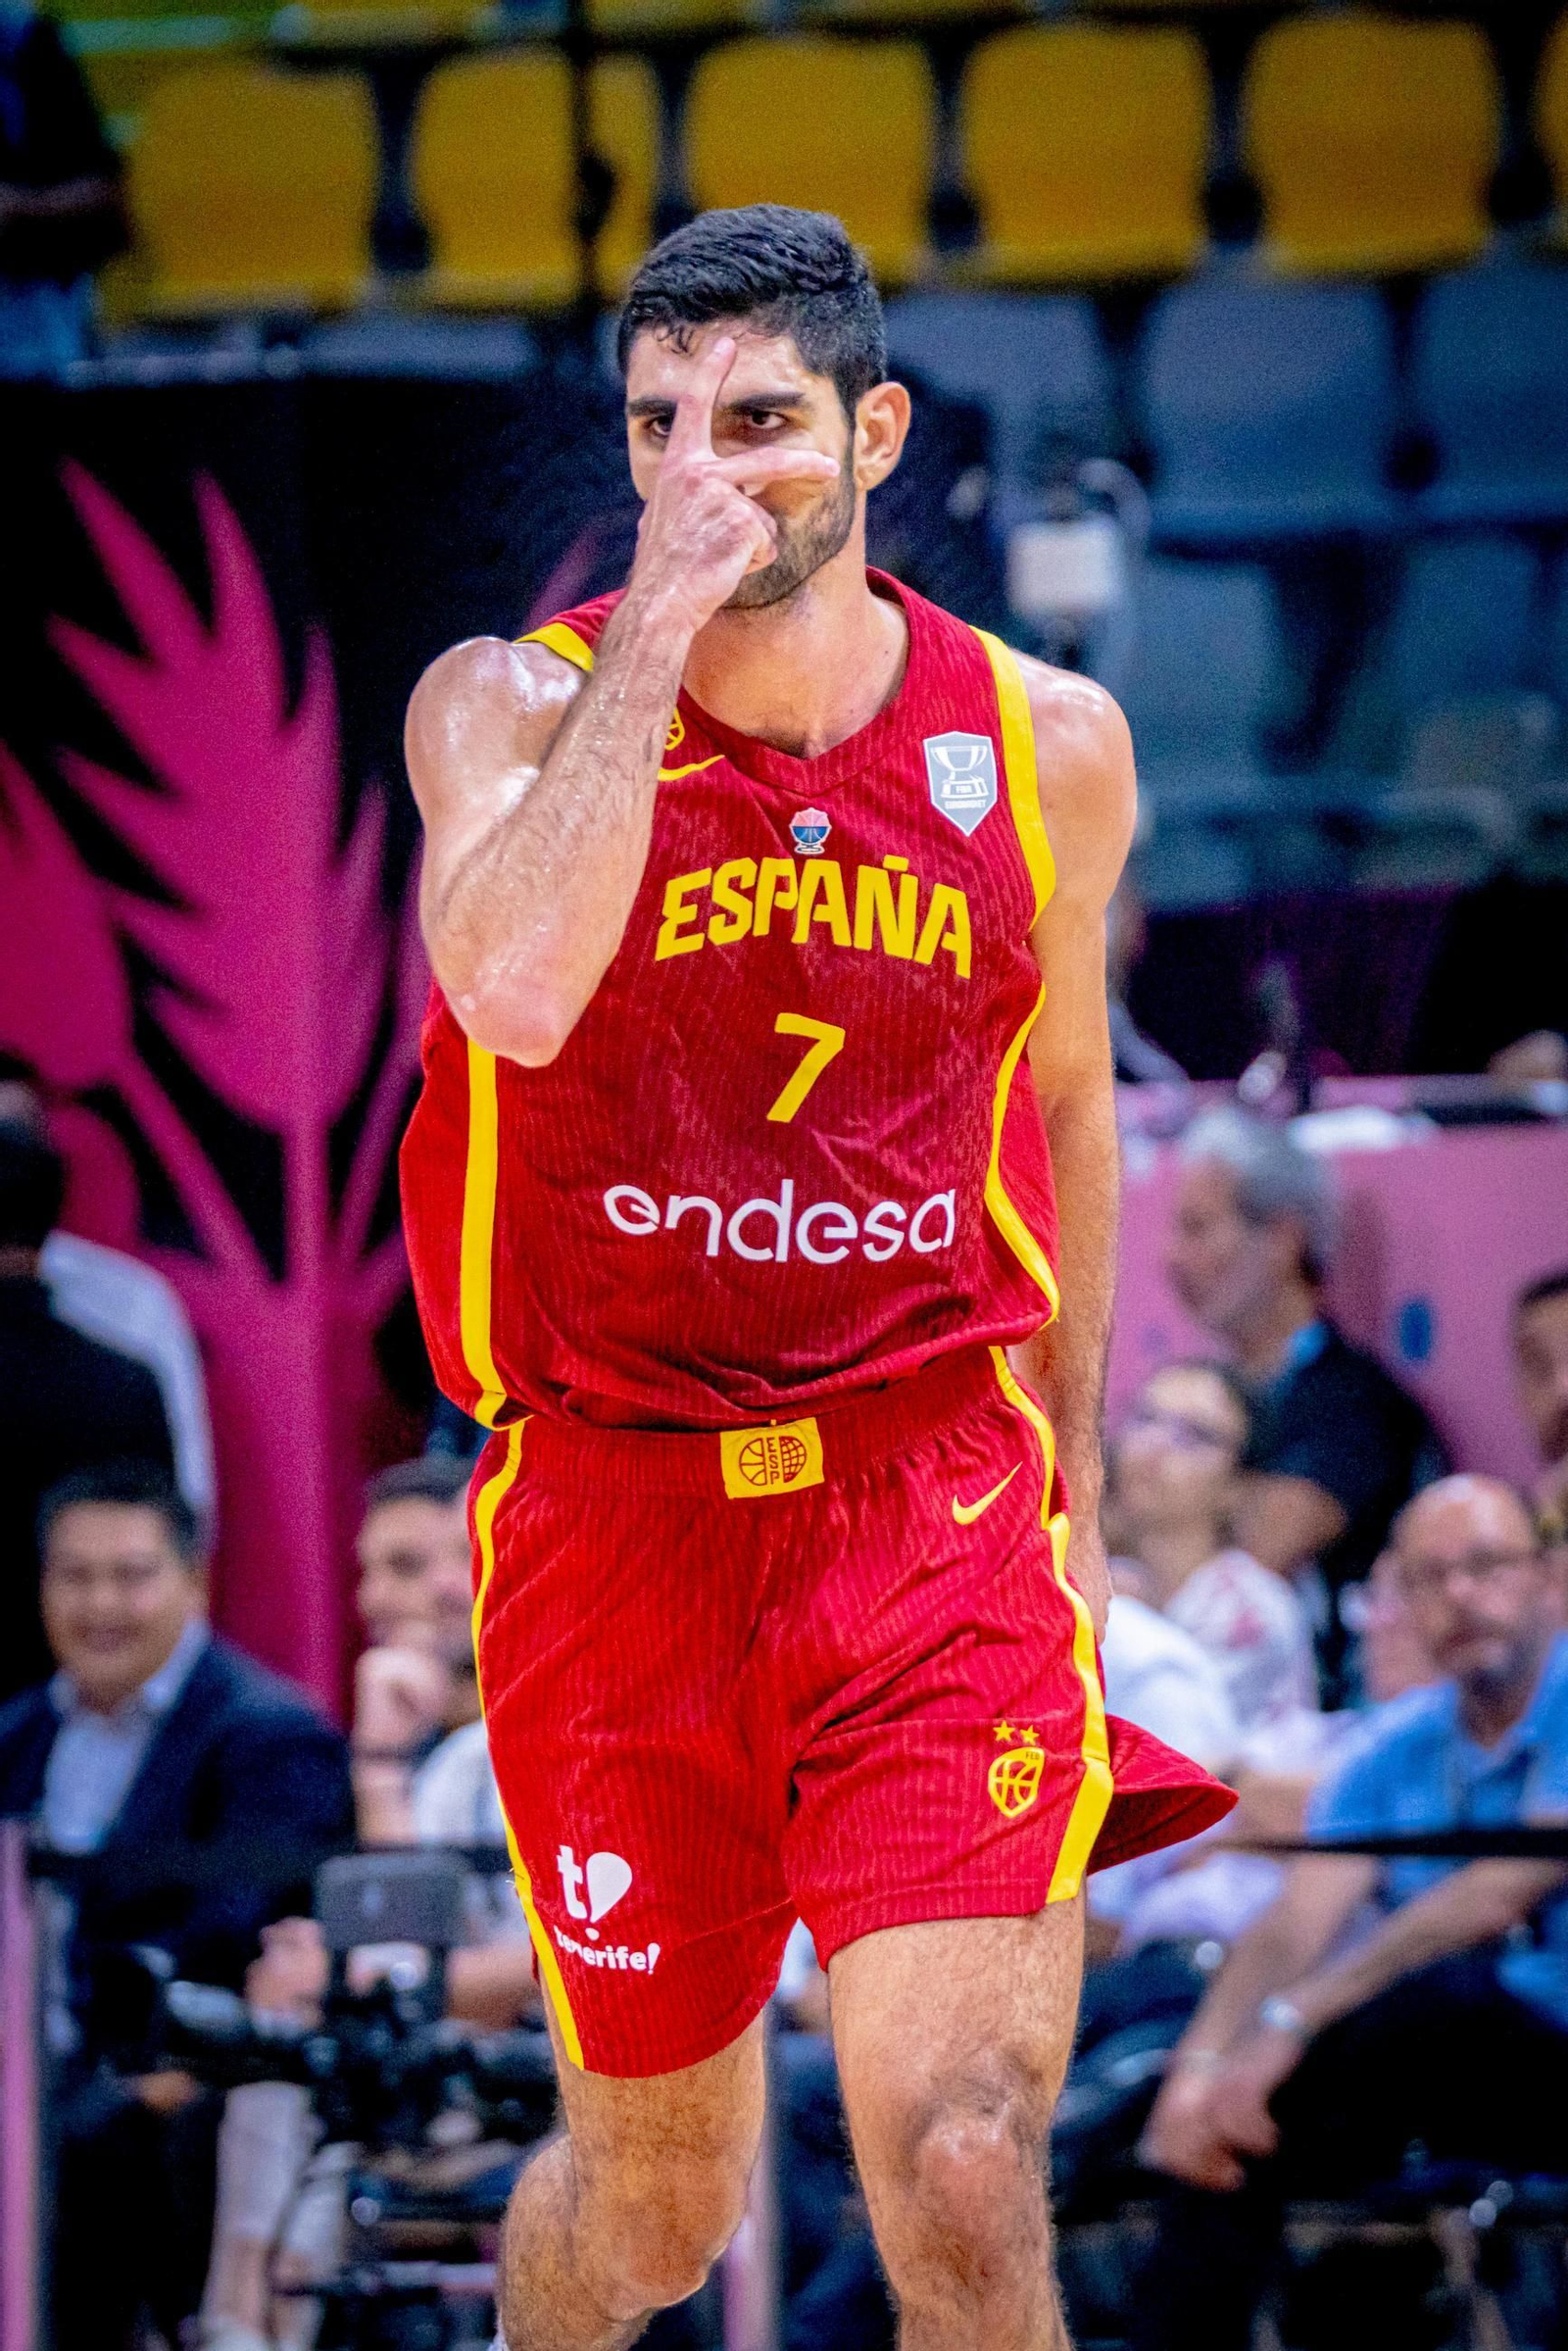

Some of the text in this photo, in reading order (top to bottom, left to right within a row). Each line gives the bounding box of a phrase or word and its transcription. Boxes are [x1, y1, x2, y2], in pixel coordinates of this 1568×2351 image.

[656, 855, 971, 979] ESPAÑA
[767, 1012, 846, 1123] 7
[604, 1179, 956, 1263] endesa
[766, 1437, 780, 1485] ESP
